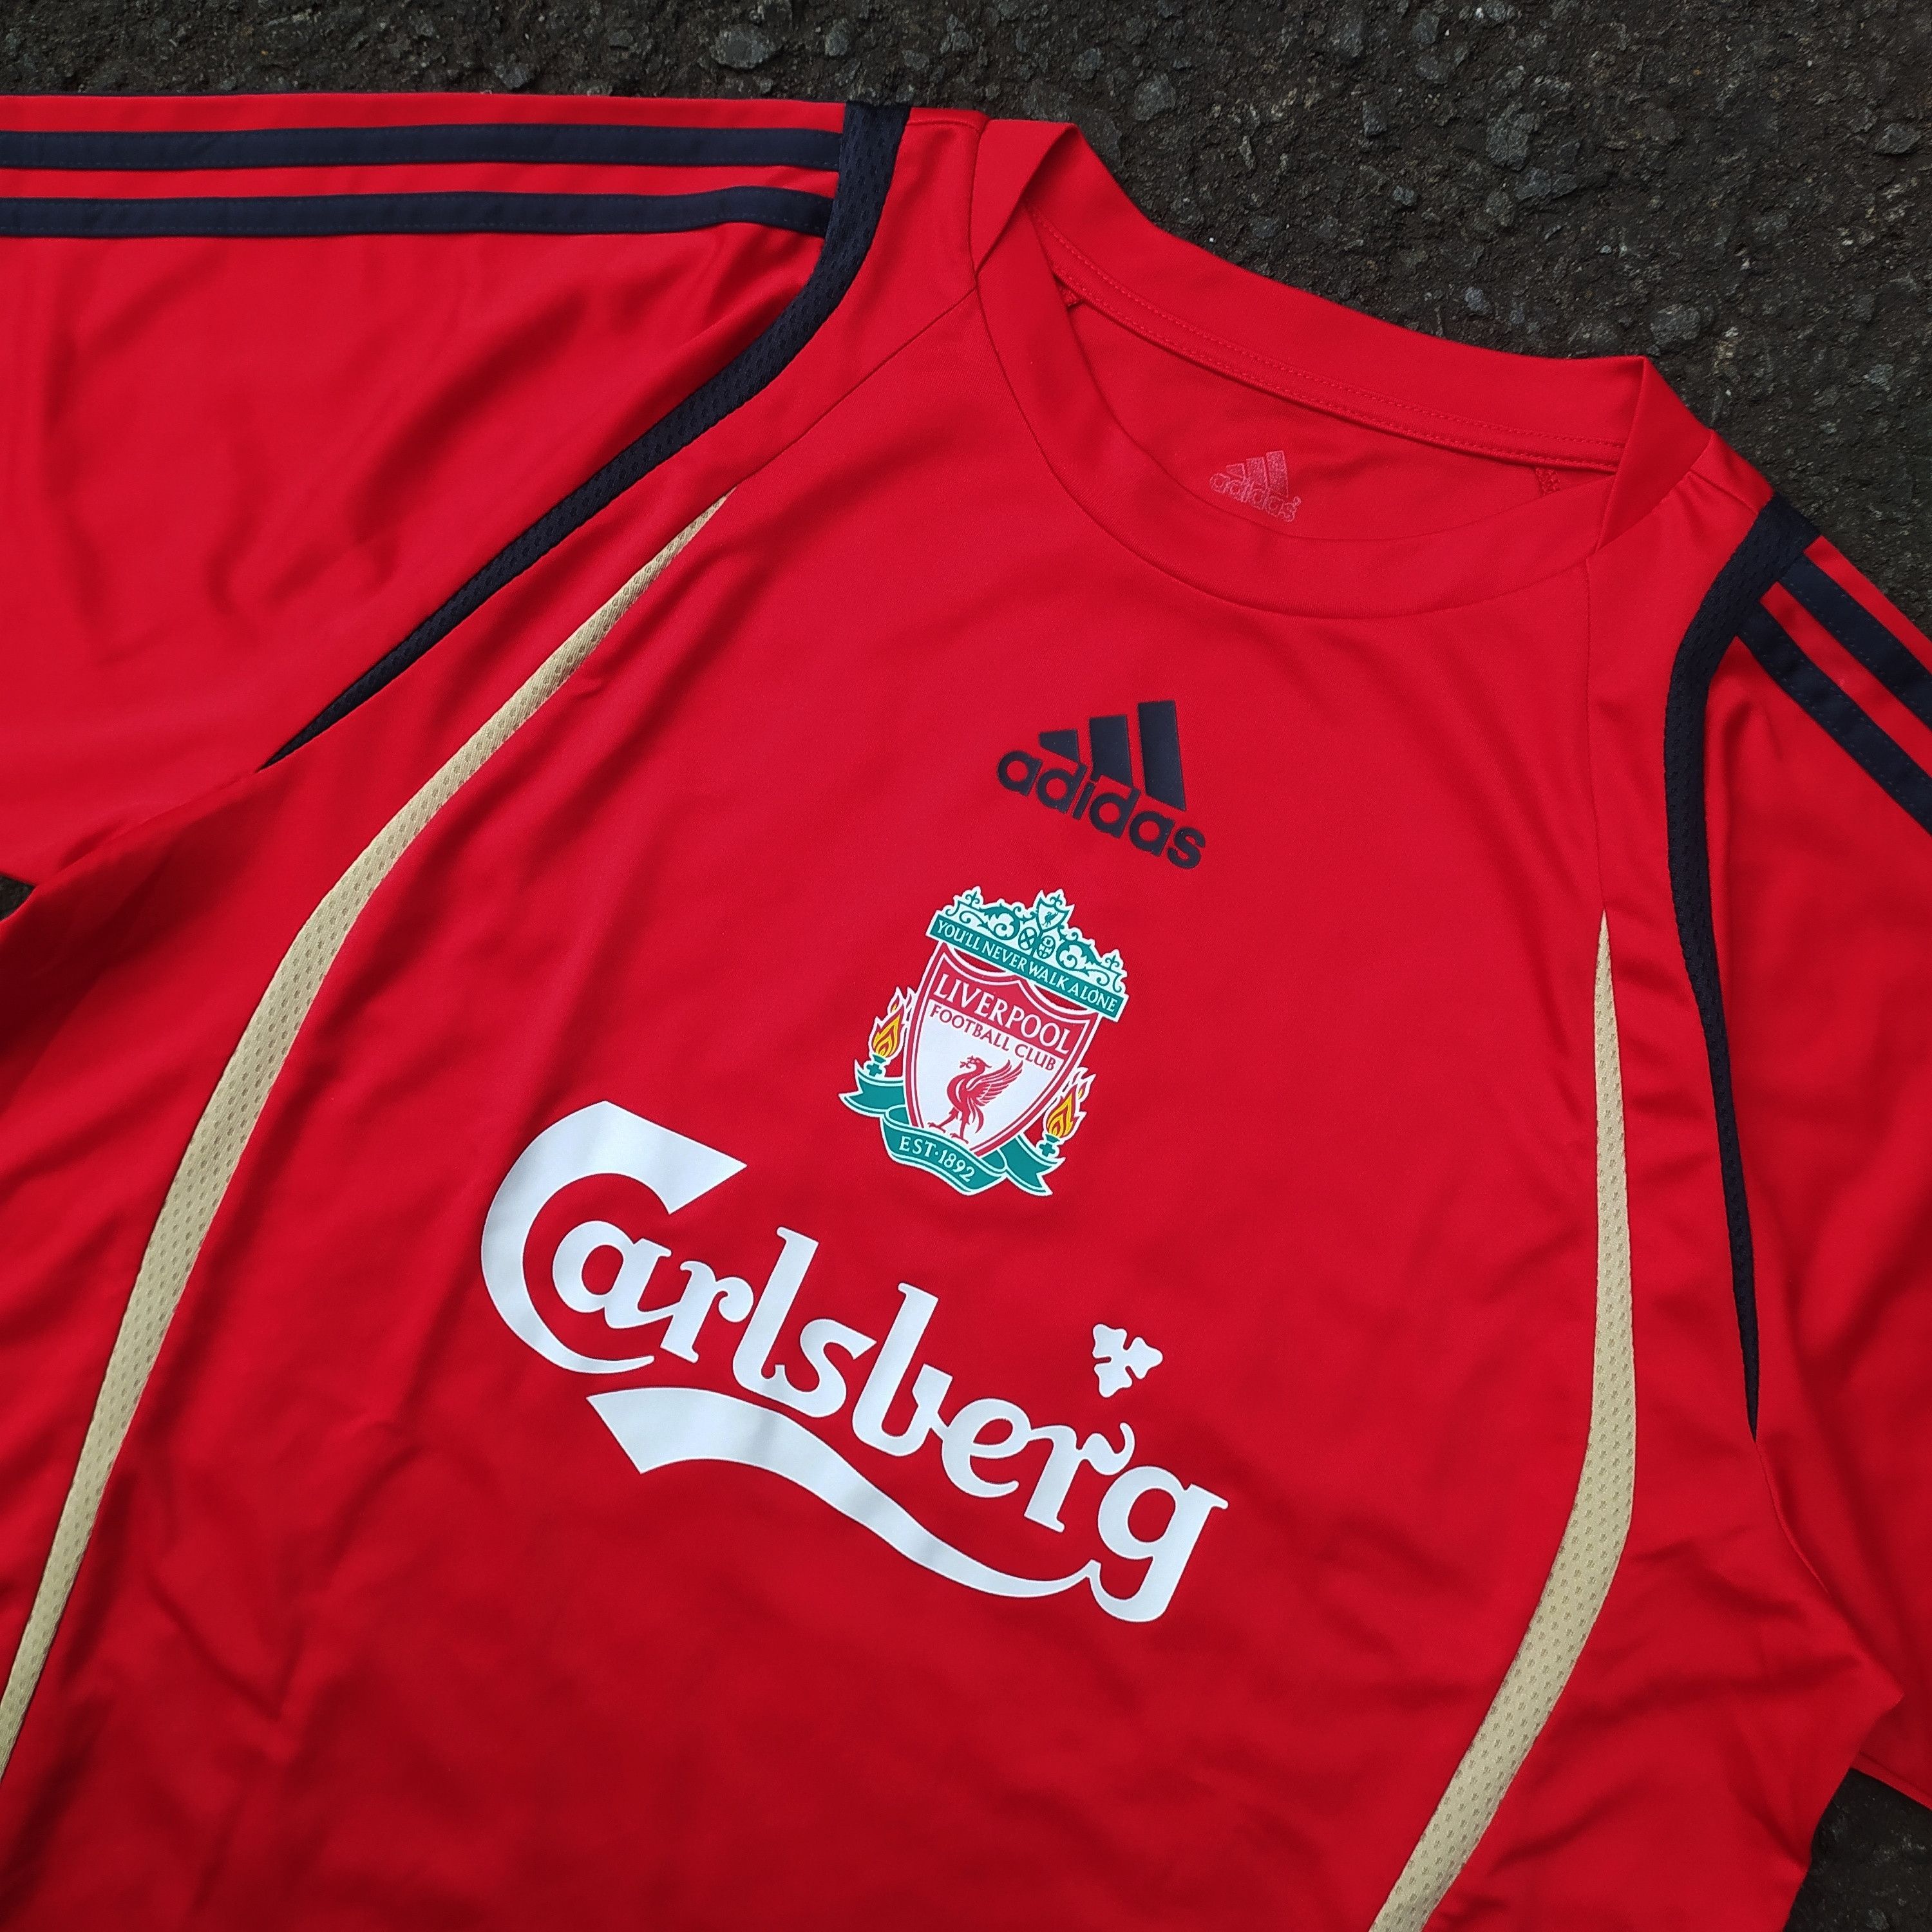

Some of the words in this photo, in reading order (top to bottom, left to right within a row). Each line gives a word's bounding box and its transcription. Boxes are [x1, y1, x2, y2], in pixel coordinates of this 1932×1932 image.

[997, 750, 1206, 869] adidas
[938, 920, 980, 951] YOU'LL
[983, 940, 1025, 972] NEVER
[1029, 961, 1070, 990] WALK
[1068, 982, 1117, 1012] ALONE
[929, 1004, 1009, 1052] FOOTBALL
[1014, 1043, 1057, 1072] CLUB
[933, 973, 1070, 1055] LIVERPOOL
[481, 1100, 1229, 1622] Carlsberg
